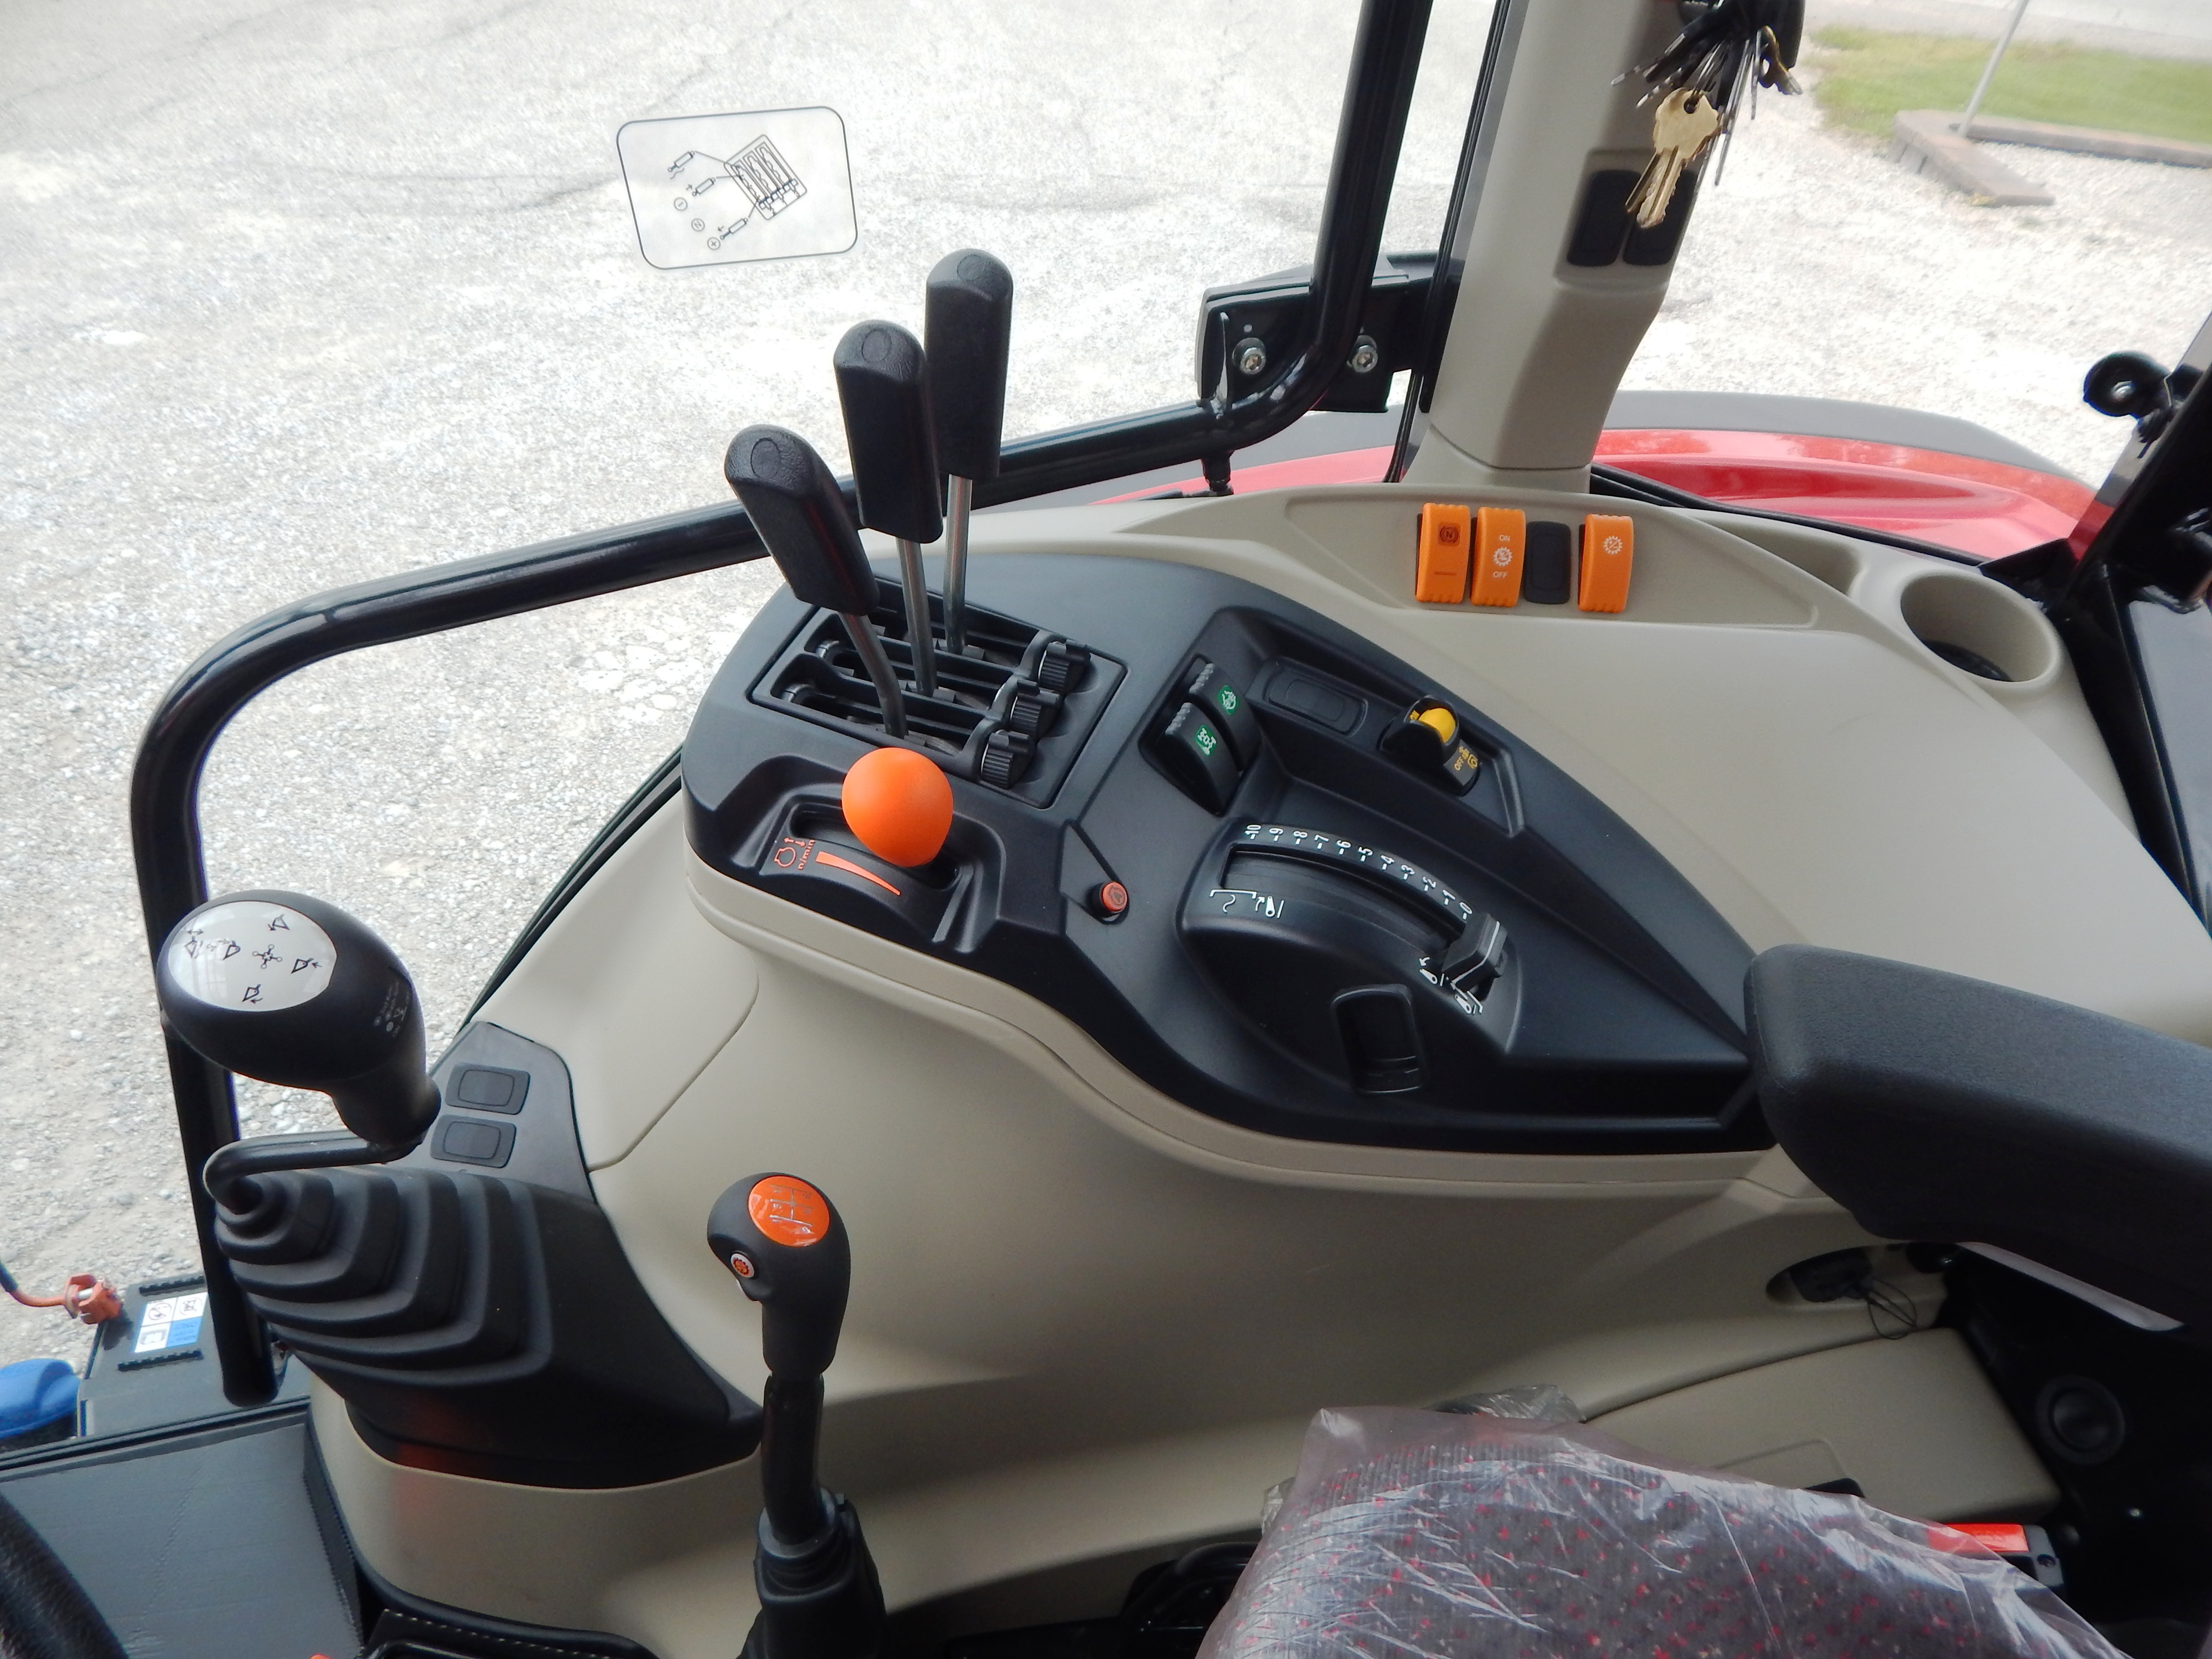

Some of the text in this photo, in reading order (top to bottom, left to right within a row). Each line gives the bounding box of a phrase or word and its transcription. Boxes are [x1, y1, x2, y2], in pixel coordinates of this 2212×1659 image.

[1455, 757, 1464, 770] OFF
[798, 840, 815, 869] n/min
[1244, 824, 1261, 835] 10
[1336, 840, 1351, 848] 6
[1358, 847, 1373, 856] 5
[1381, 855, 1395, 864] 4
[1401, 865, 1415, 875] 3
[1423, 877, 1436, 888] 2
[1442, 890, 1455, 900] 1
[1460, 902, 1472, 914] 0
